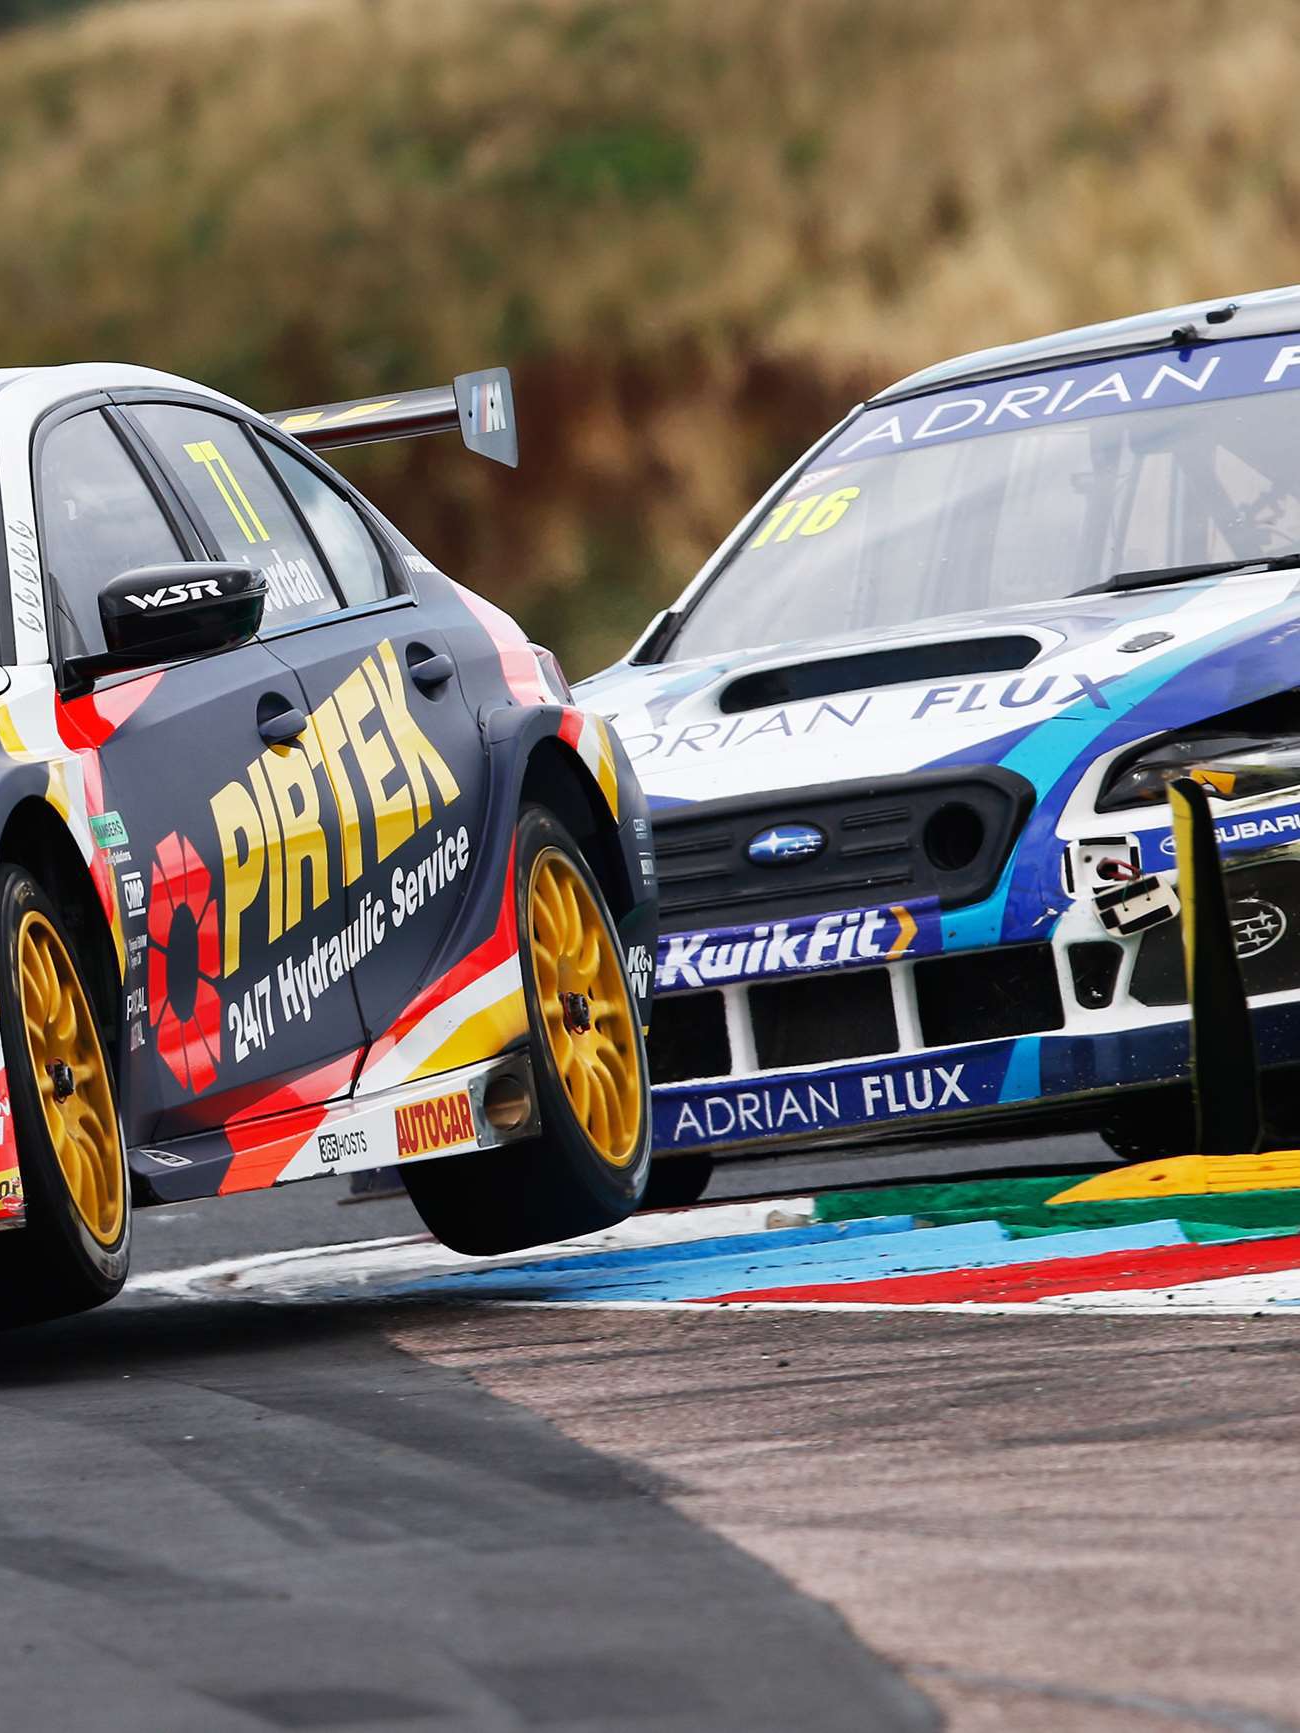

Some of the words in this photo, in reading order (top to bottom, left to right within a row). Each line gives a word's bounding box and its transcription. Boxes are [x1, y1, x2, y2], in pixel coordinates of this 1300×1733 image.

[837, 355, 1221, 456] ADRIAN
[183, 440, 270, 544] 77
[749, 486, 861, 549] 116
[124, 579, 223, 610] WSR
[242, 549, 325, 613] ordan
[620, 695, 872, 762] DRIAN
[911, 673, 1124, 720] FLUX
[210, 638, 461, 980] PIRTEK
[228, 975, 276, 1064] 24/7
[277, 891, 387, 1024] Hydraulic
[390, 825, 470, 928] Service
[395, 1092, 475, 1156] AUTOCAR
[674, 1083, 840, 1141] ADRIAN
[861, 1064, 970, 1117] FLUX
